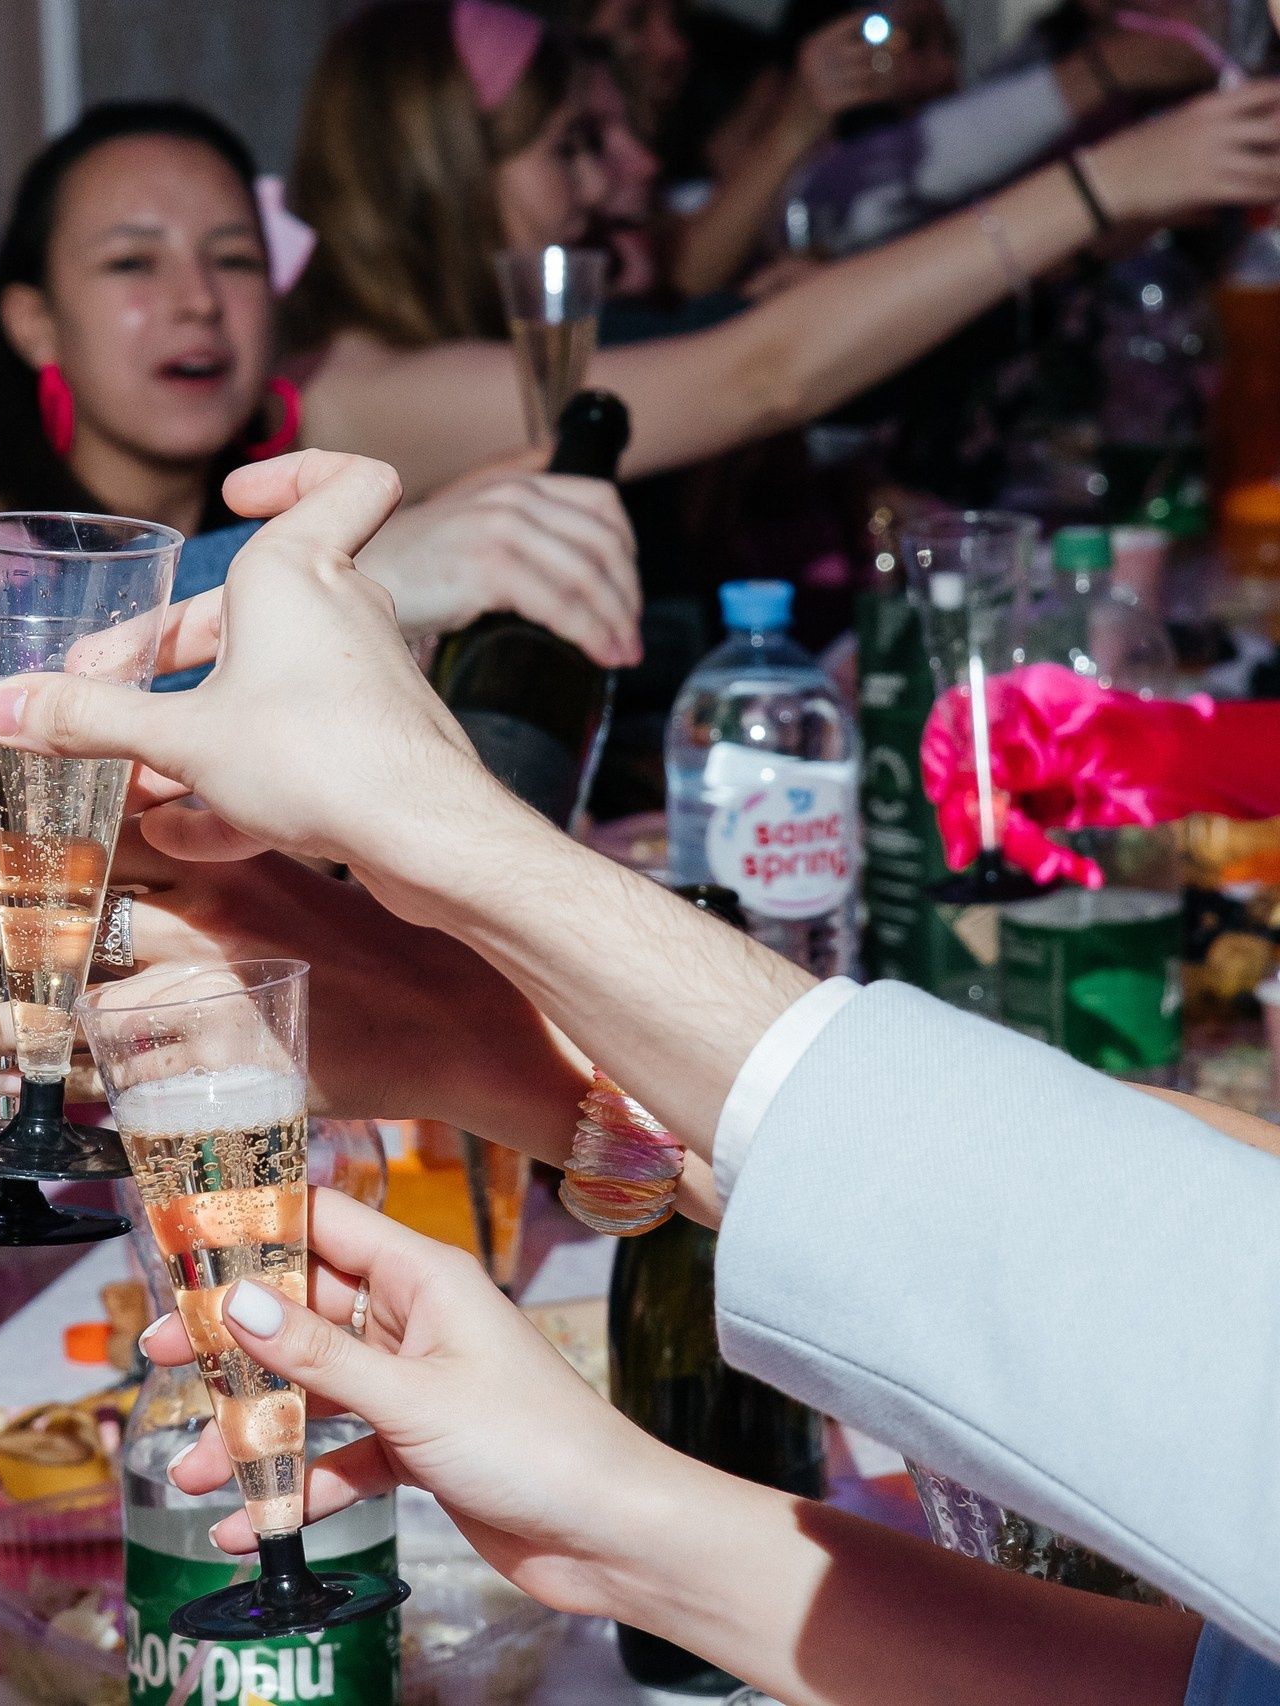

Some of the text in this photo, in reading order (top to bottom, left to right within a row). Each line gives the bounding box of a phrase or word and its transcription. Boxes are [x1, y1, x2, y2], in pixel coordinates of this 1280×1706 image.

[755, 813, 839, 846] saint
[742, 846, 848, 887] spring
[125, 1603, 336, 1706] Добрый
